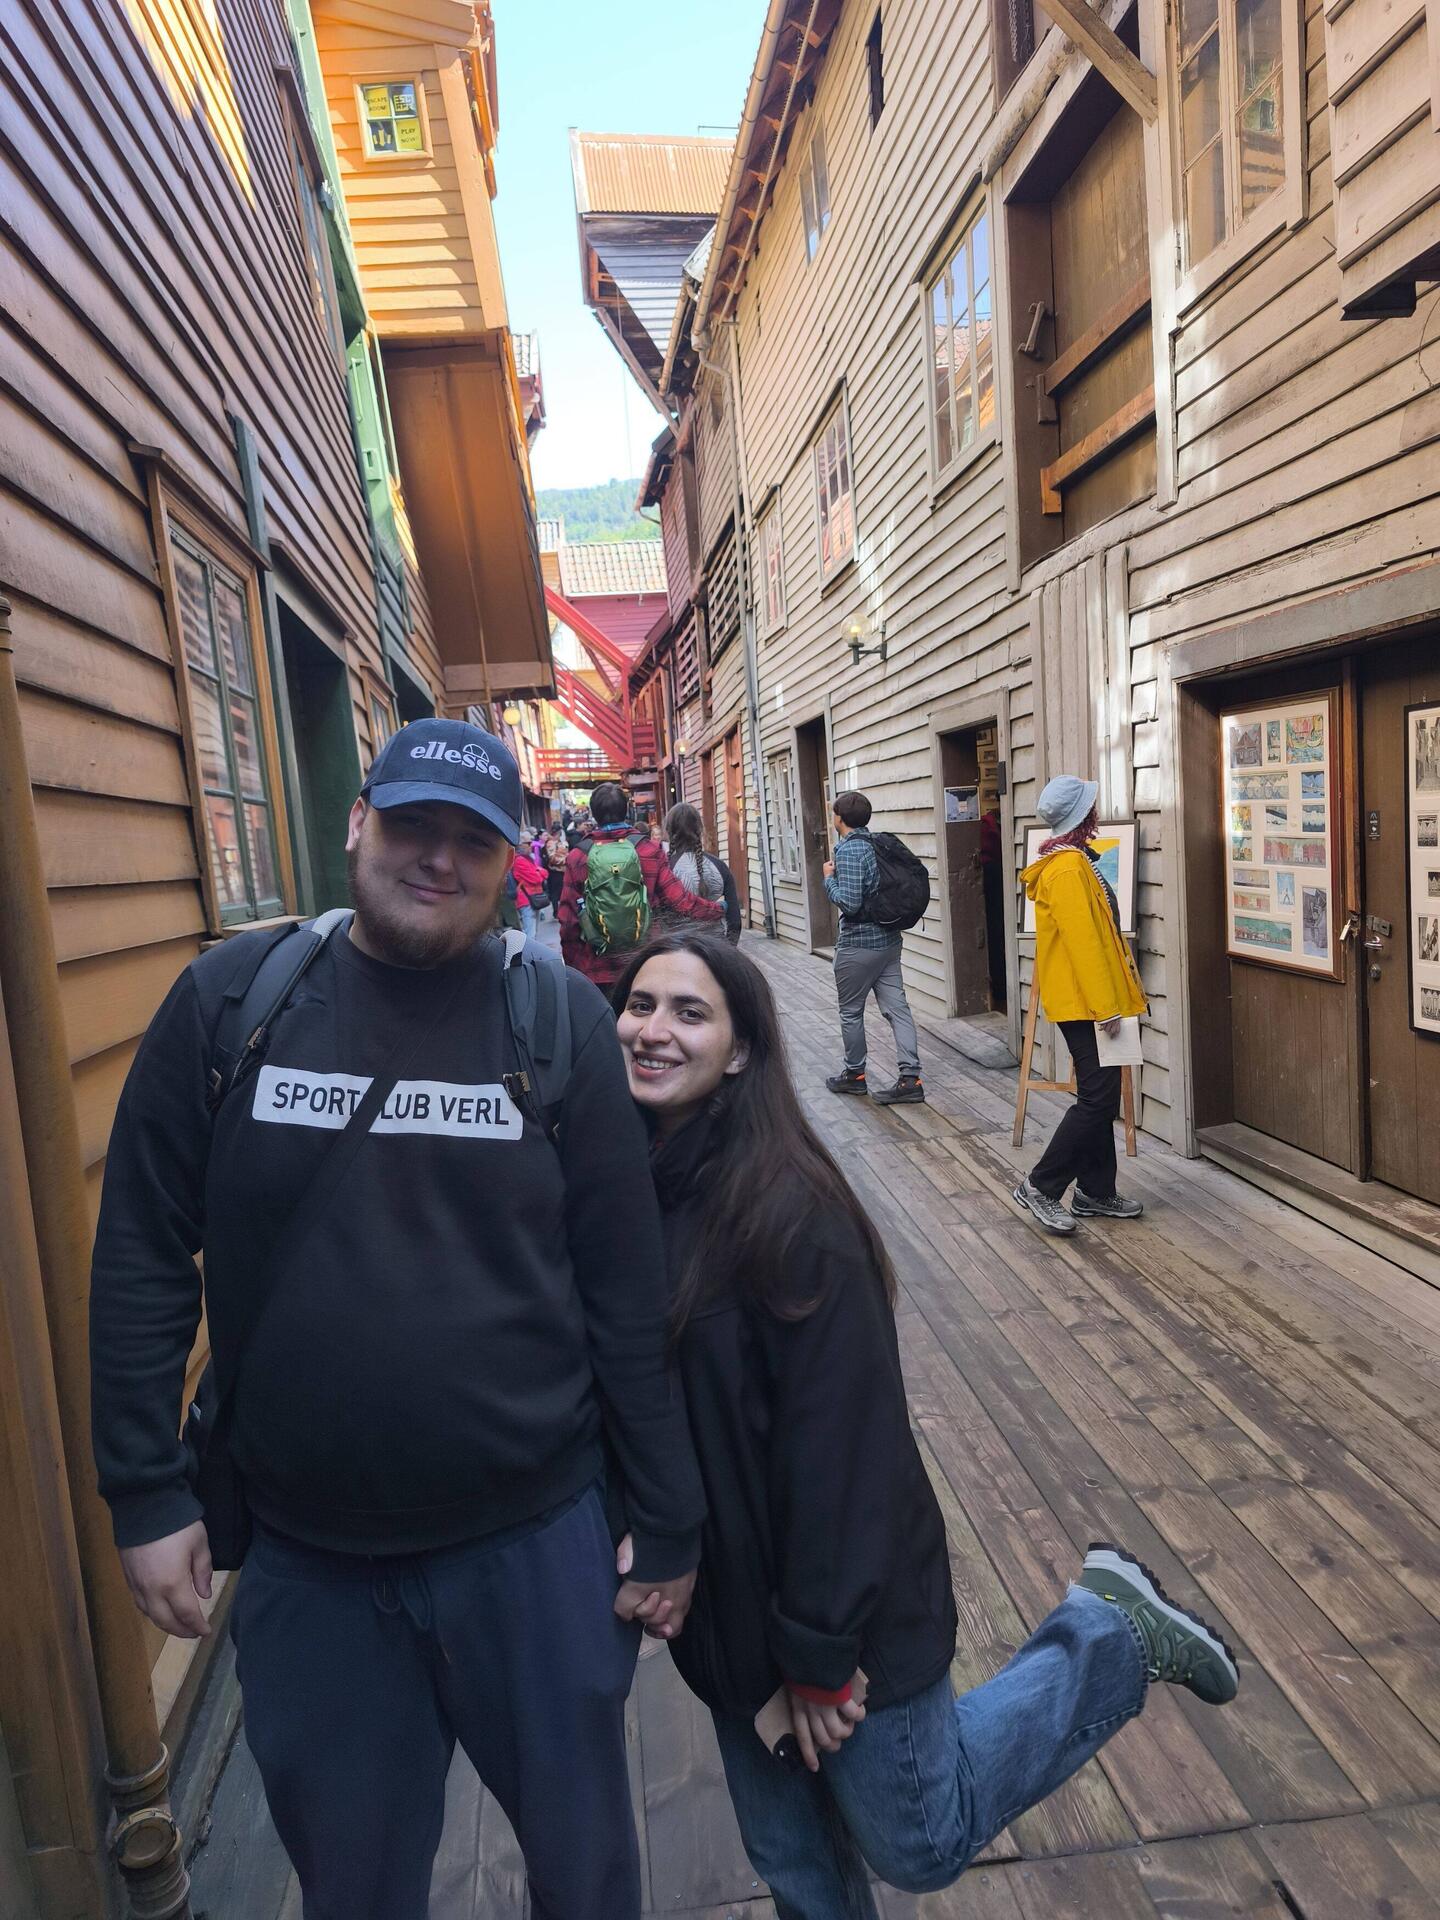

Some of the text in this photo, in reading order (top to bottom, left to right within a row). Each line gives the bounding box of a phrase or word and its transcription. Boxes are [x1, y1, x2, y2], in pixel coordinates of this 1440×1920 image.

[410, 741, 502, 781] ellesse
[272, 1081, 509, 1126] SPORTLUB VERL
